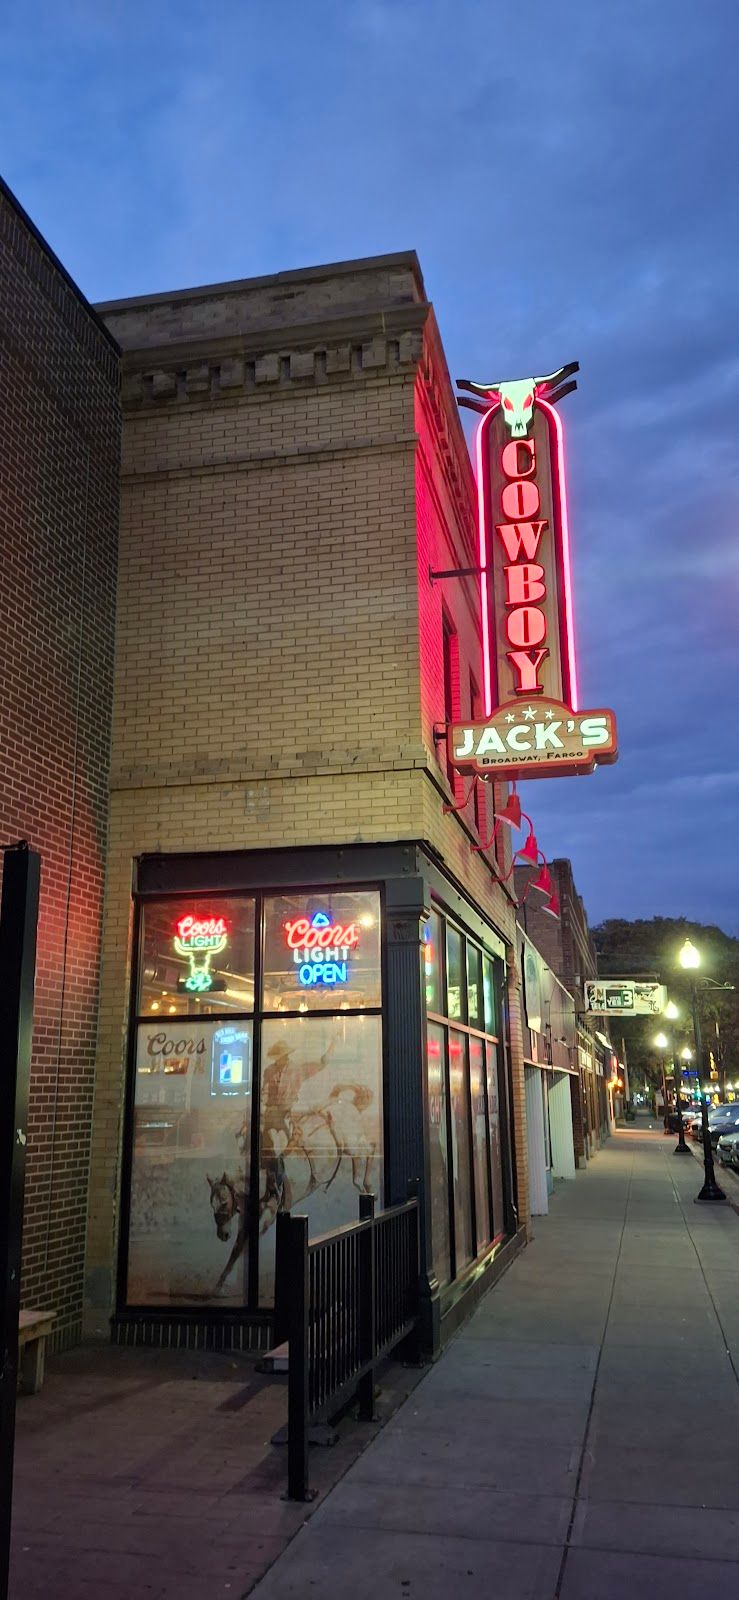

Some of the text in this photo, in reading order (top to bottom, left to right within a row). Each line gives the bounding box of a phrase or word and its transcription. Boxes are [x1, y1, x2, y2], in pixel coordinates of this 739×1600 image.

[495, 438, 549, 693] COWBOY
[455, 717, 610, 757] JACK'S
[178, 915, 227, 935] Coors
[284, 918, 359, 949] Coors
[182, 935, 222, 947] LIGHT
[293, 946, 351, 964] LIGHT
[299, 962, 347, 985] OPEN
[622, 990, 633, 1006] 3
[147, 1031, 207, 1056] Coors
